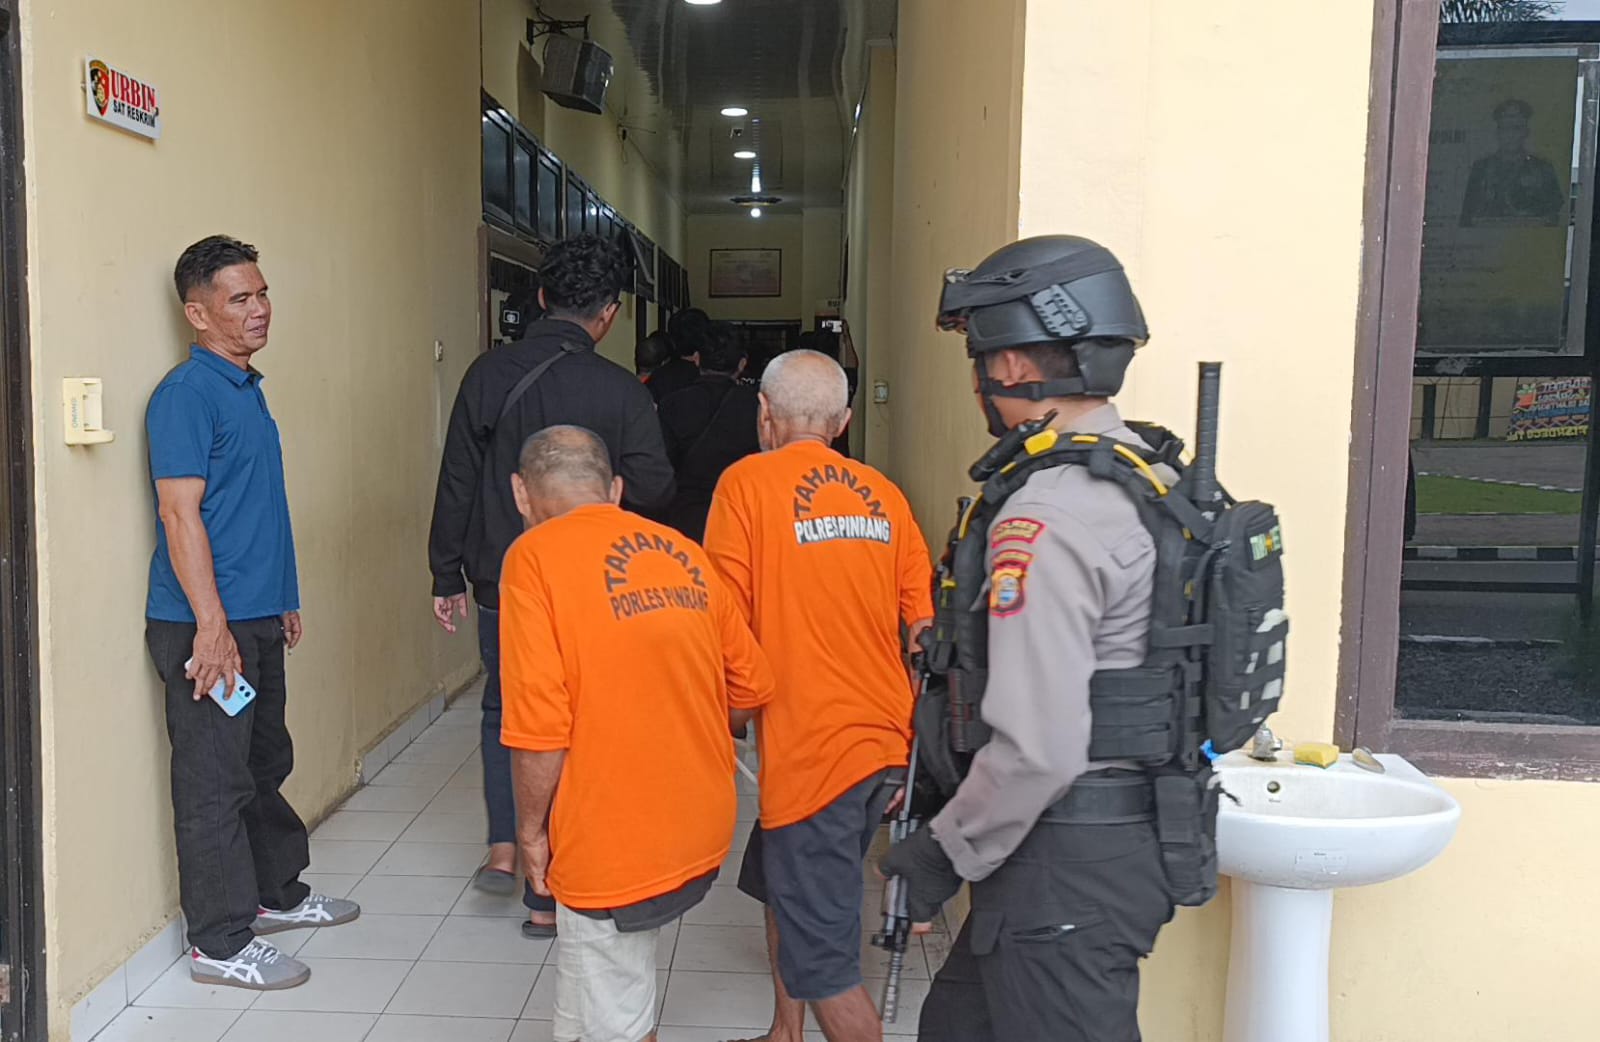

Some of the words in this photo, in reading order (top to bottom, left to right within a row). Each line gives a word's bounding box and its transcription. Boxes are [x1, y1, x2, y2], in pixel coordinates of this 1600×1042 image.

[110, 68, 156, 112] URBIN
[113, 99, 125, 115] SAT
[794, 464, 887, 518] TAHANAN
[604, 532, 706, 593] TAHANAN
